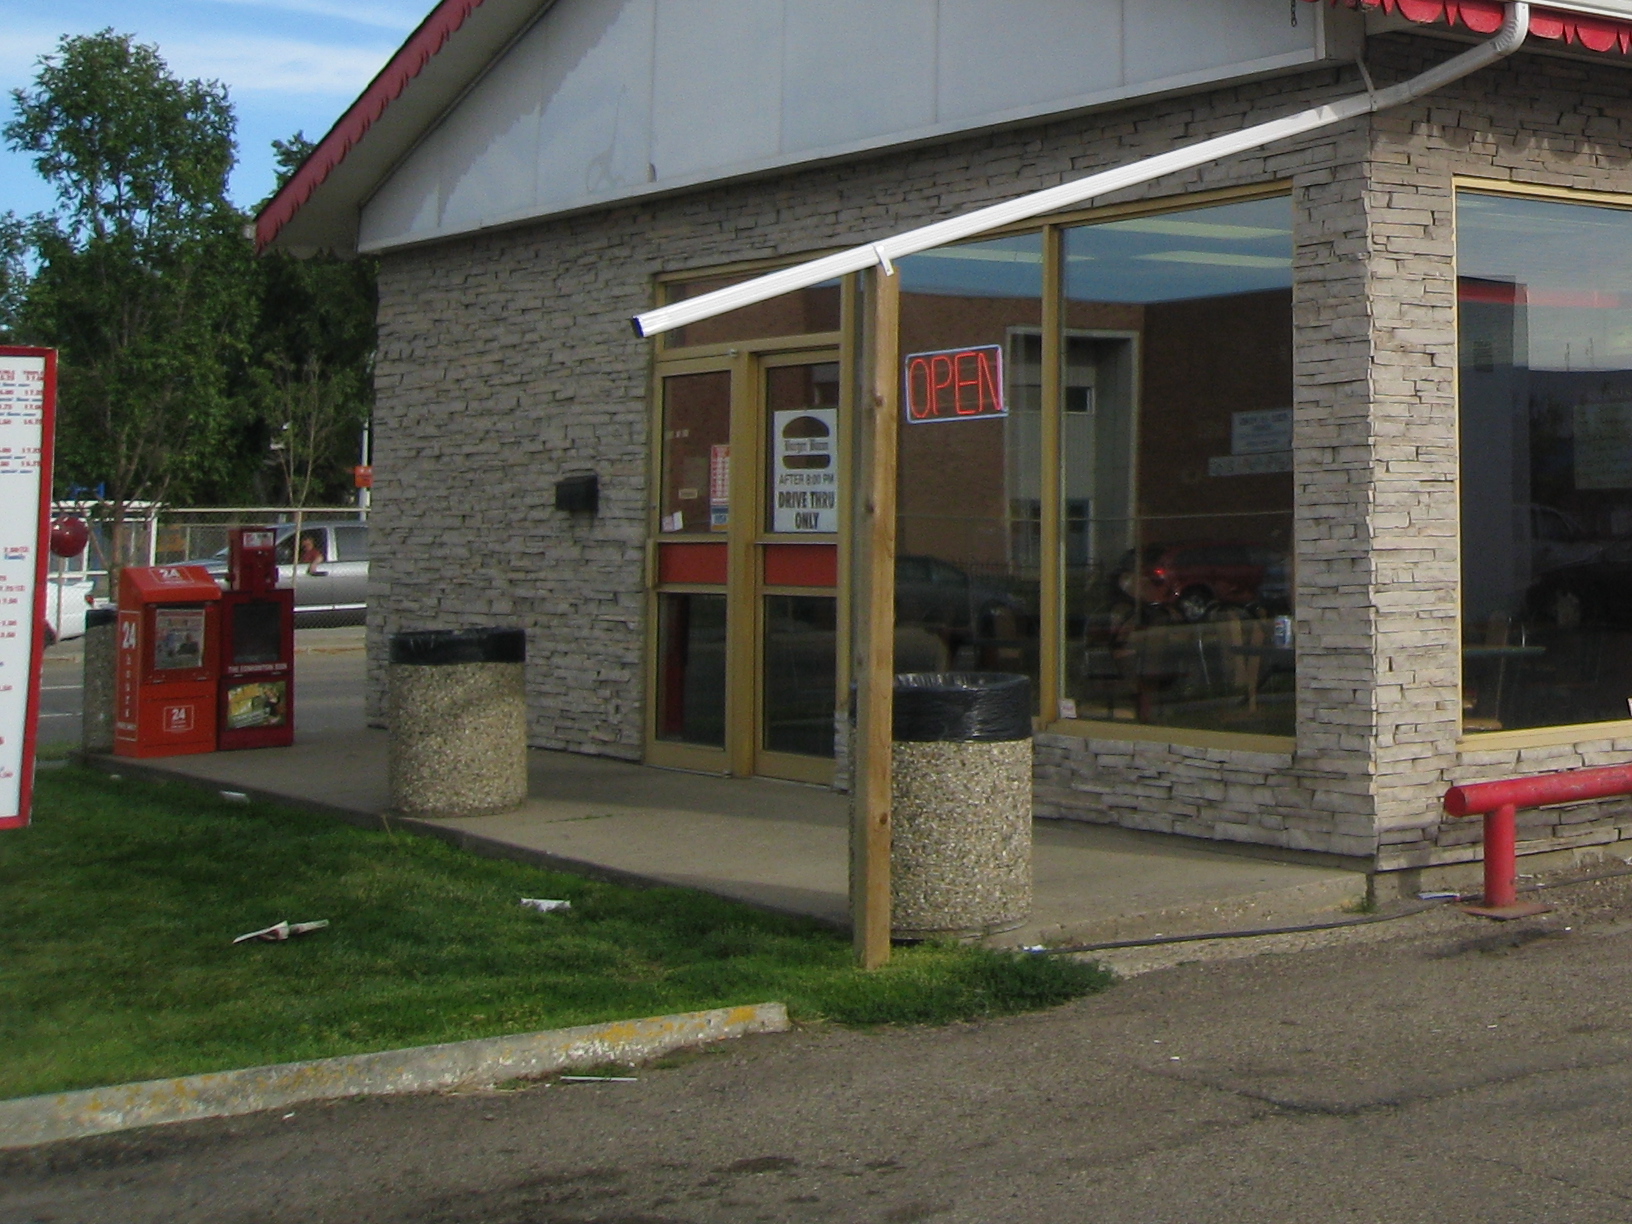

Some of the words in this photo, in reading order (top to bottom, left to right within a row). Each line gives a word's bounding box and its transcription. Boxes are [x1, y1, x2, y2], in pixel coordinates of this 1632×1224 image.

[908, 350, 1004, 418] OPEN
[779, 474, 804, 485] AFTER
[778, 491, 807, 508] DRIVE
[810, 491, 835, 509] THRU
[795, 512, 819, 530] ONLY
[122, 621, 136, 649] 24
[172, 708, 186, 720] 24
